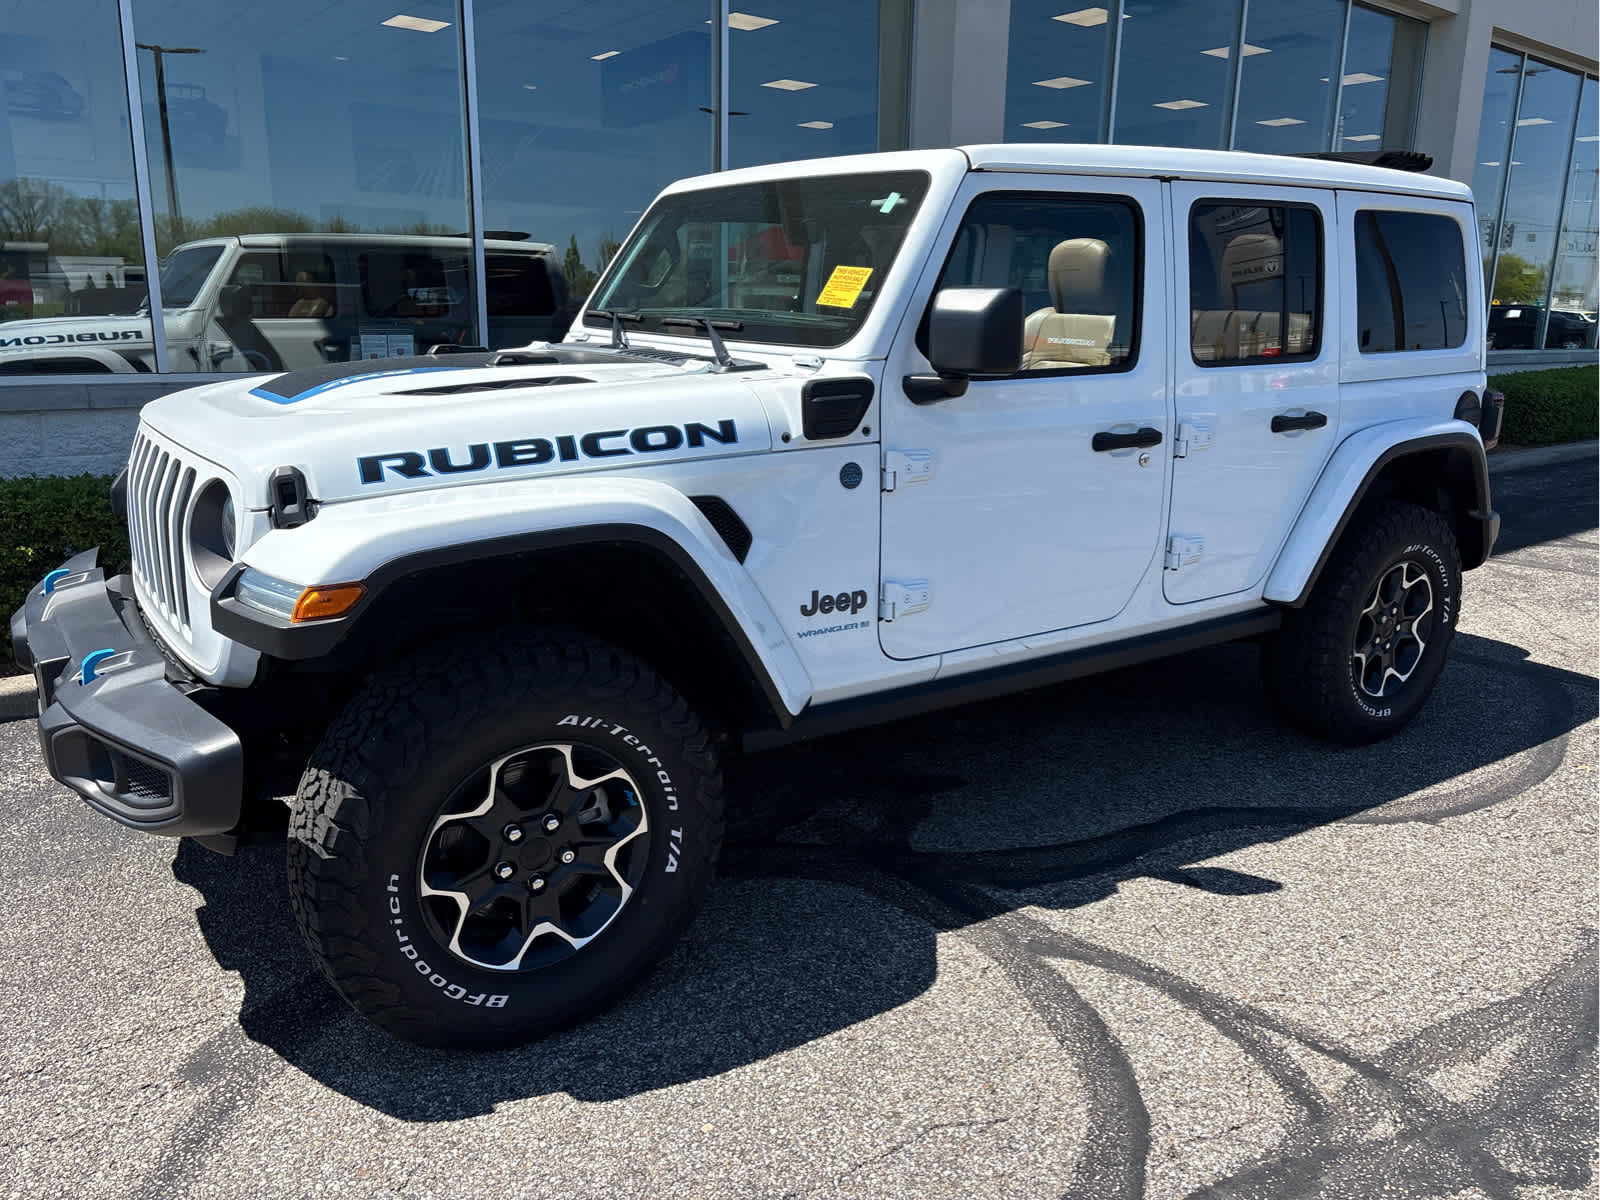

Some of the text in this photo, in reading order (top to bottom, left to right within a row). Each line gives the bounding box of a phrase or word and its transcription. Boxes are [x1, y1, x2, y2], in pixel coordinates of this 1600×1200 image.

[356, 418, 739, 485] RUBICON
[800, 589, 868, 618] Jeep
[1403, 544, 1451, 624] All-Terrain T/A
[796, 622, 859, 639] WRANGLER
[1348, 655, 1392, 718] BFGood
[556, 714, 684, 874] All-Terrain T/A
[386, 873, 510, 1009] BFGoodrich
